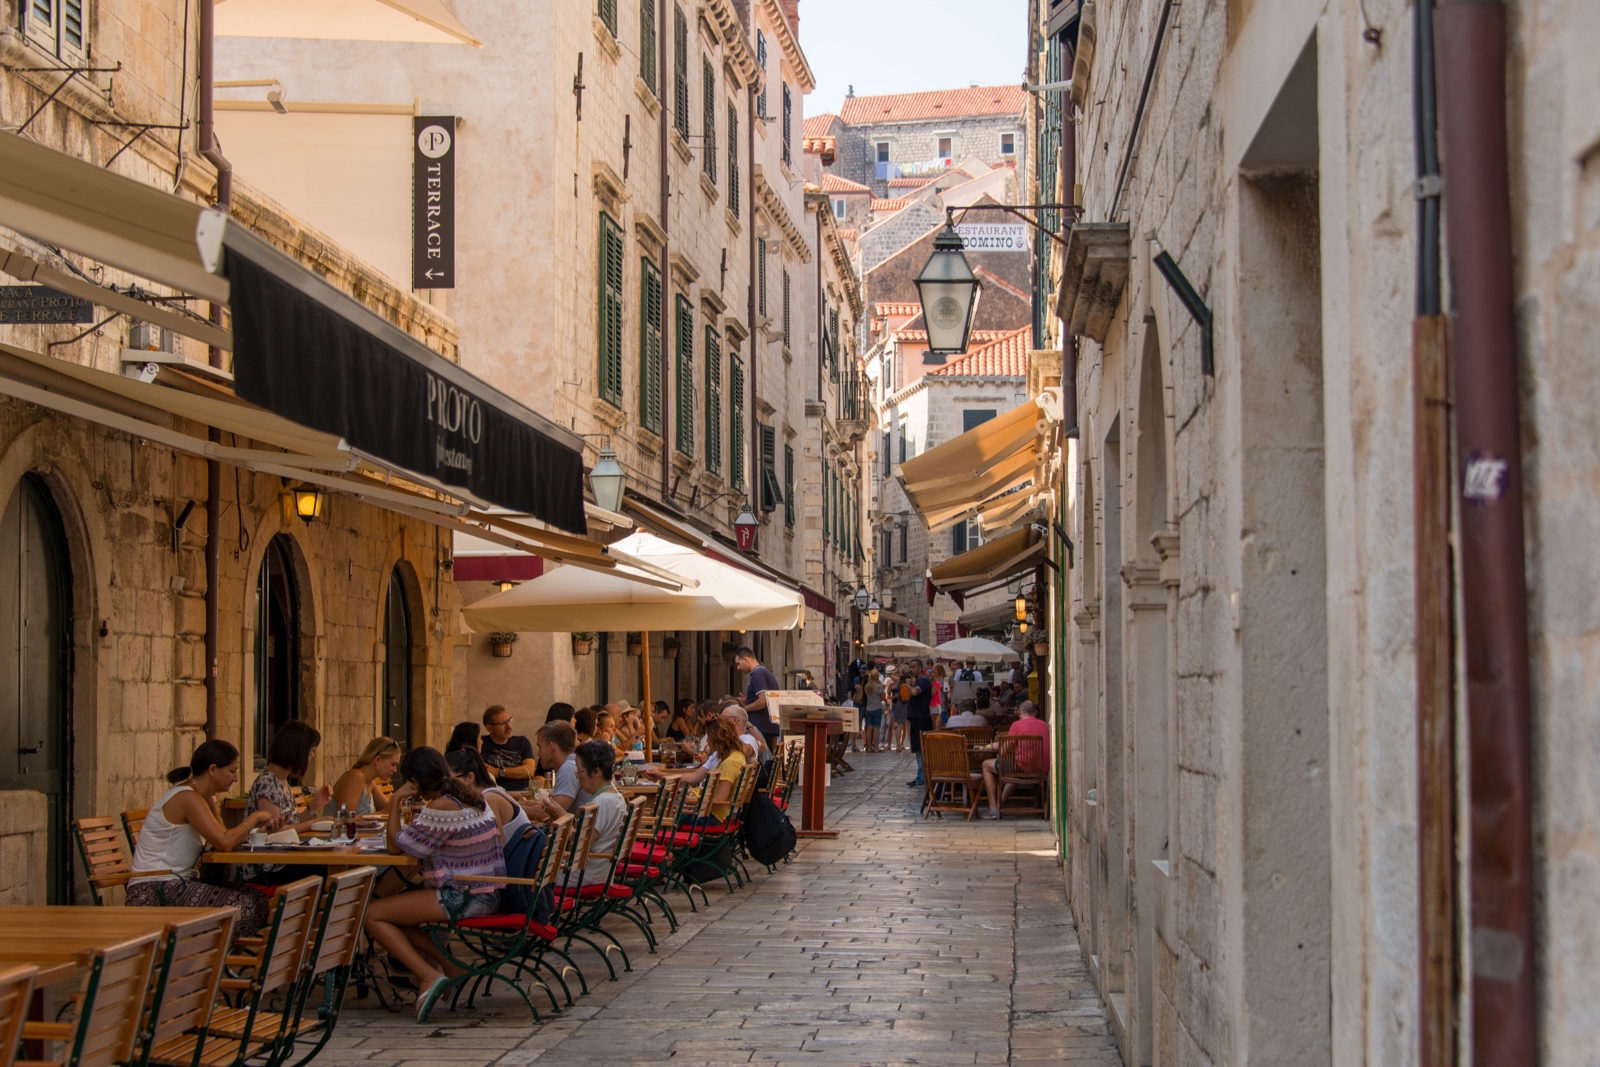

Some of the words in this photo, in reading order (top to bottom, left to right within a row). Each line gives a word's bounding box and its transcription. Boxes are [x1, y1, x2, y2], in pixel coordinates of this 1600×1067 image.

[427, 132, 444, 151] P
[427, 163, 441, 259] TERRACE
[962, 236, 1013, 248] DOMINO
[41, 297, 87, 308] PROTO
[15, 310, 78, 321] TERRACE
[426, 373, 482, 445] PROTO
